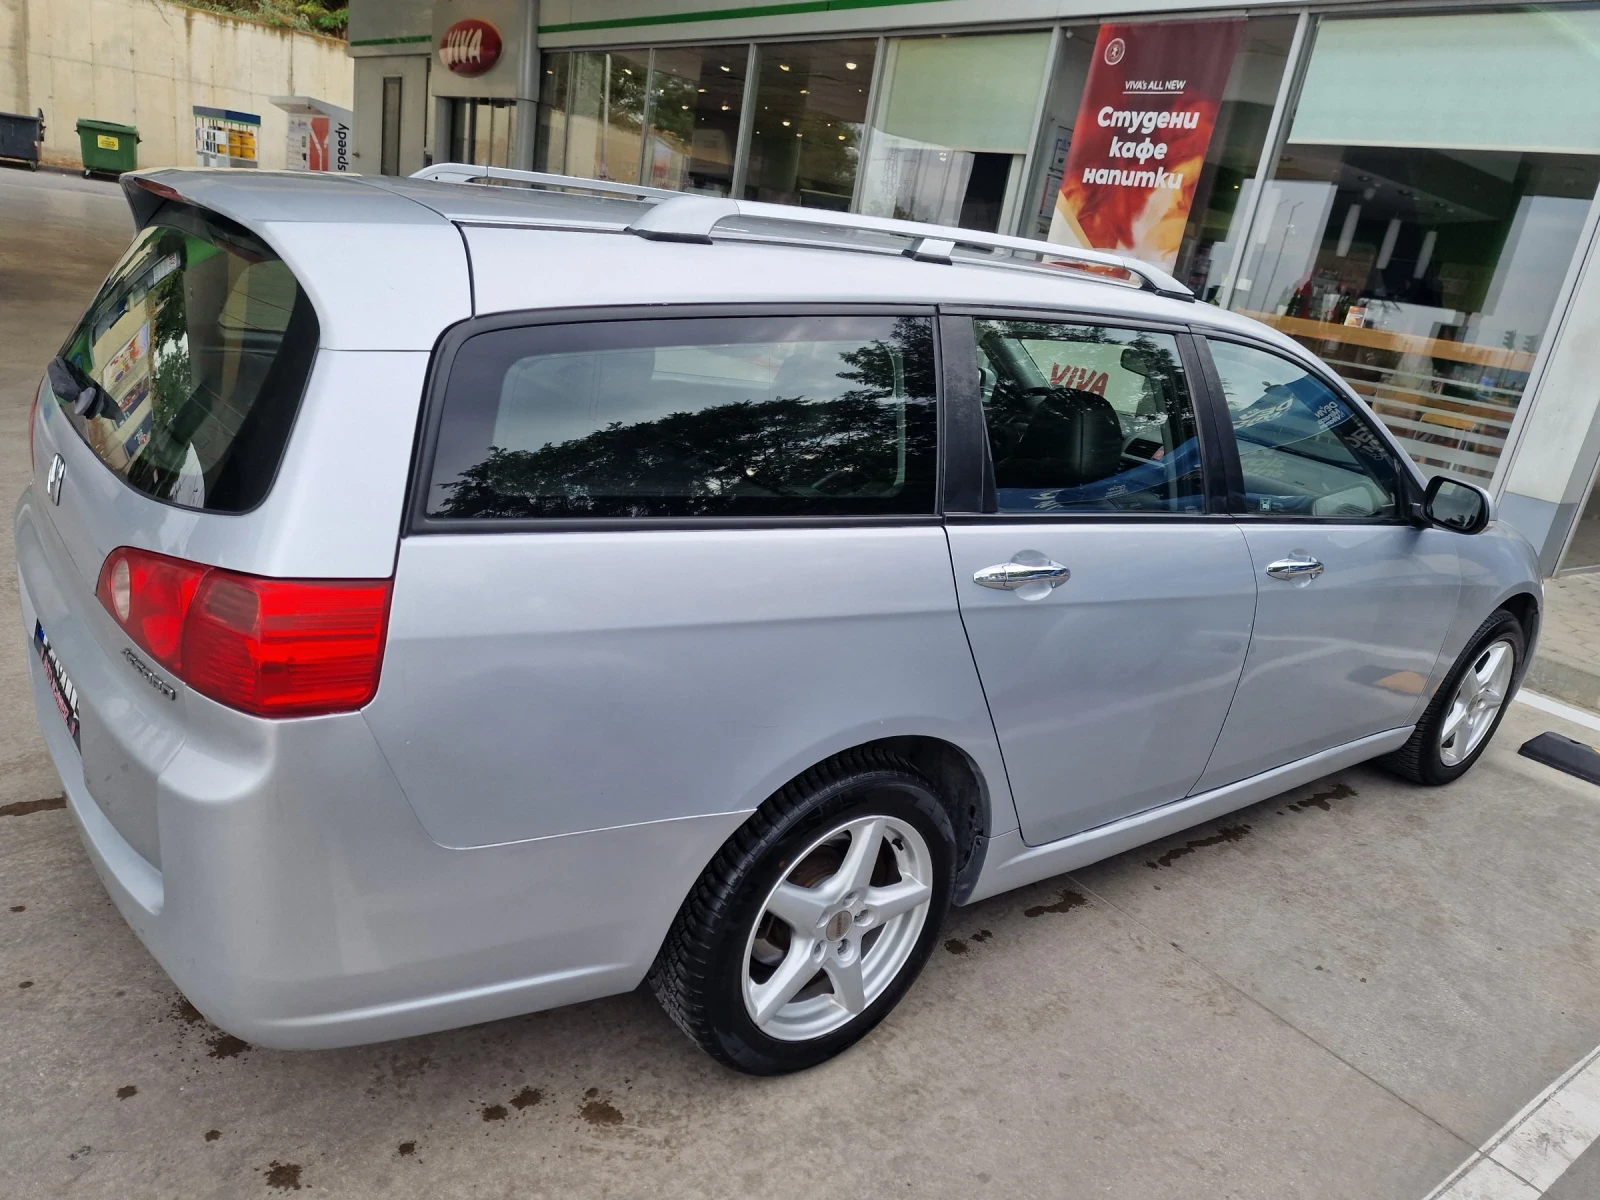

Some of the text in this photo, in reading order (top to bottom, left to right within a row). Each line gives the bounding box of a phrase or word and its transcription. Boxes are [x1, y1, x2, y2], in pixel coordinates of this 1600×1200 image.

[446, 28, 483, 65] VIVA
[1125, 80, 1187, 90] VIVA's ALL NEW
[1097, 106, 1200, 134] Студени
[335, 122, 350, 171] speedy
[1109, 136, 1168, 164] кафе
[1082, 166, 1184, 190] напитки
[1050, 362, 1110, 397] VIVA
